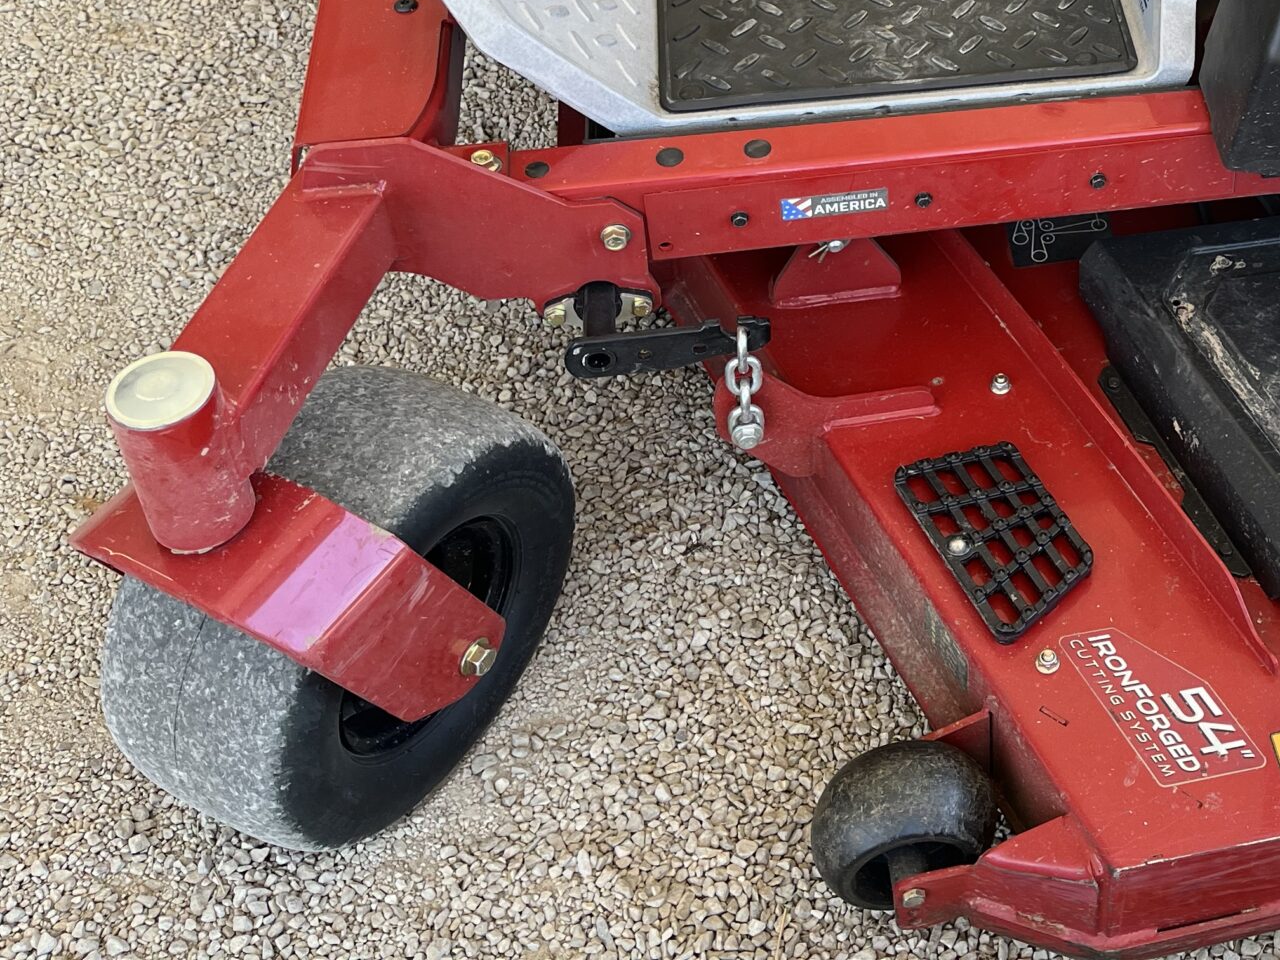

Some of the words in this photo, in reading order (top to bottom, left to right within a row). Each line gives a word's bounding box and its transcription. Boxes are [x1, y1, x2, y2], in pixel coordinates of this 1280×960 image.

[814, 198, 886, 215] AMERICA
[821, 193, 868, 204] ASSEMBLED
[1070, 639, 1125, 706] CUTTING
[1120, 711, 1176, 777] SYSTEM
[1087, 634, 1201, 772] IRONFORGED
